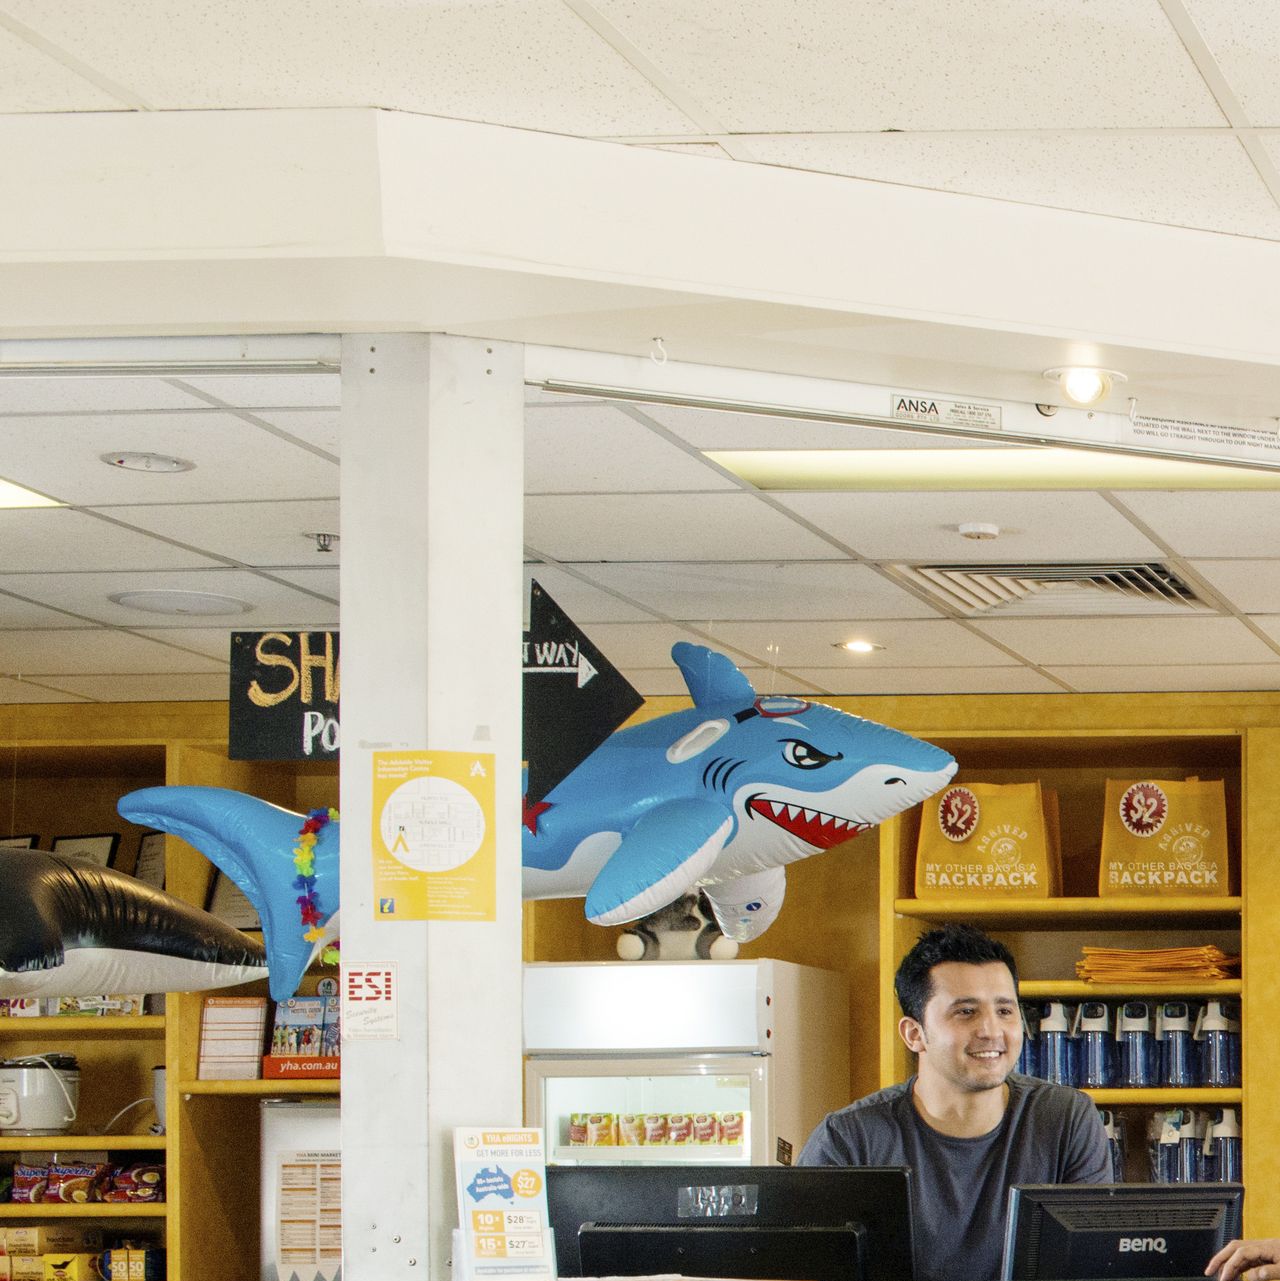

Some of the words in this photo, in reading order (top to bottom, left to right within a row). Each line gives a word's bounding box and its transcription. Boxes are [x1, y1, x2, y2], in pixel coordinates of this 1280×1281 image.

[896, 398, 939, 415] ANSA
[1133, 421, 1160, 430] SITUATED
[1232, 432, 1257, 440] WINDOW
[1133, 428, 1146, 436] YOU
[1170, 432, 1197, 440] STRAIGHT
[1197, 435, 1225, 444] THROUGH
[533, 639, 579, 667] WAY
[248, 631, 341, 708] SH
[947, 795, 972, 830] $2
[1129, 791, 1158, 824] $2
[925, 863, 942, 872] MY
[945, 863, 983, 873] OTHER
[986, 863, 1011, 874] BAG
[1014, 863, 1026, 873] IS
[1108, 861, 1124, 870] MY
[1127, 861, 1165, 871] OTHER
[1168, 862, 1193, 871] BAG
[1196, 862, 1207, 870] IS
[925, 871, 1039, 887] BACKPACK
[1108, 870, 1219, 885] BACKPACK
[348, 971, 392, 1001] ESI
[279, 1059, 338, 1073] yha.com.au
[476, 1150, 490, 1158] GET
[490, 1149, 509, 1157] MORE
[510, 1149, 525, 1157] FOR
[525, 1148, 542, 1157] LESS
[1119, 1237, 1168, 1254] BenQ
[112, 1261, 127, 1272] 50
[129, 1261, 144, 1272] 50
